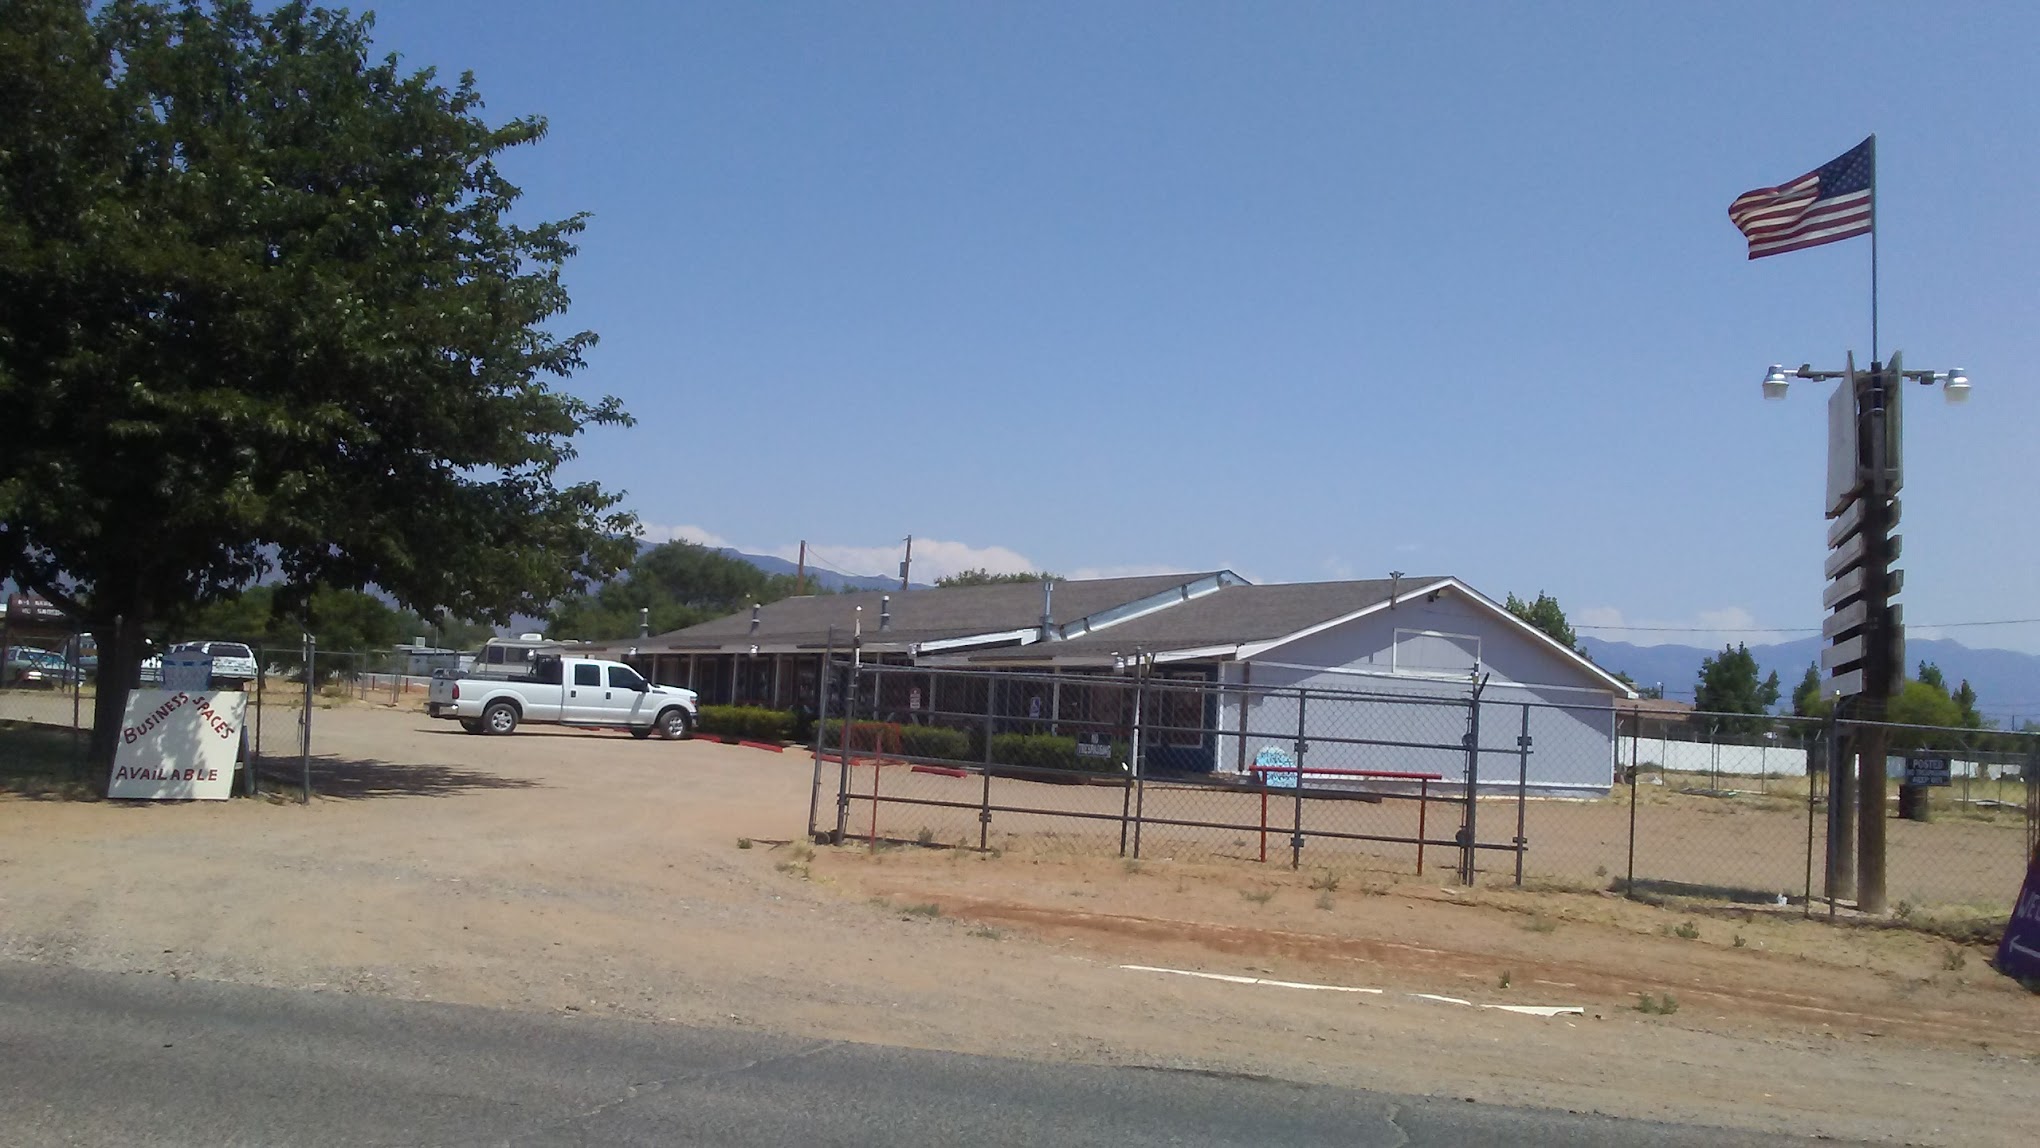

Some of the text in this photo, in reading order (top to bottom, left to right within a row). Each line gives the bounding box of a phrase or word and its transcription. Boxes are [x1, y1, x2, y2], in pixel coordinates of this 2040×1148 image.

[123, 691, 235, 744] BUSINESS SPACES
[1912, 759, 1944, 769] POSTED
[115, 765, 218, 781] AVAILABLE
